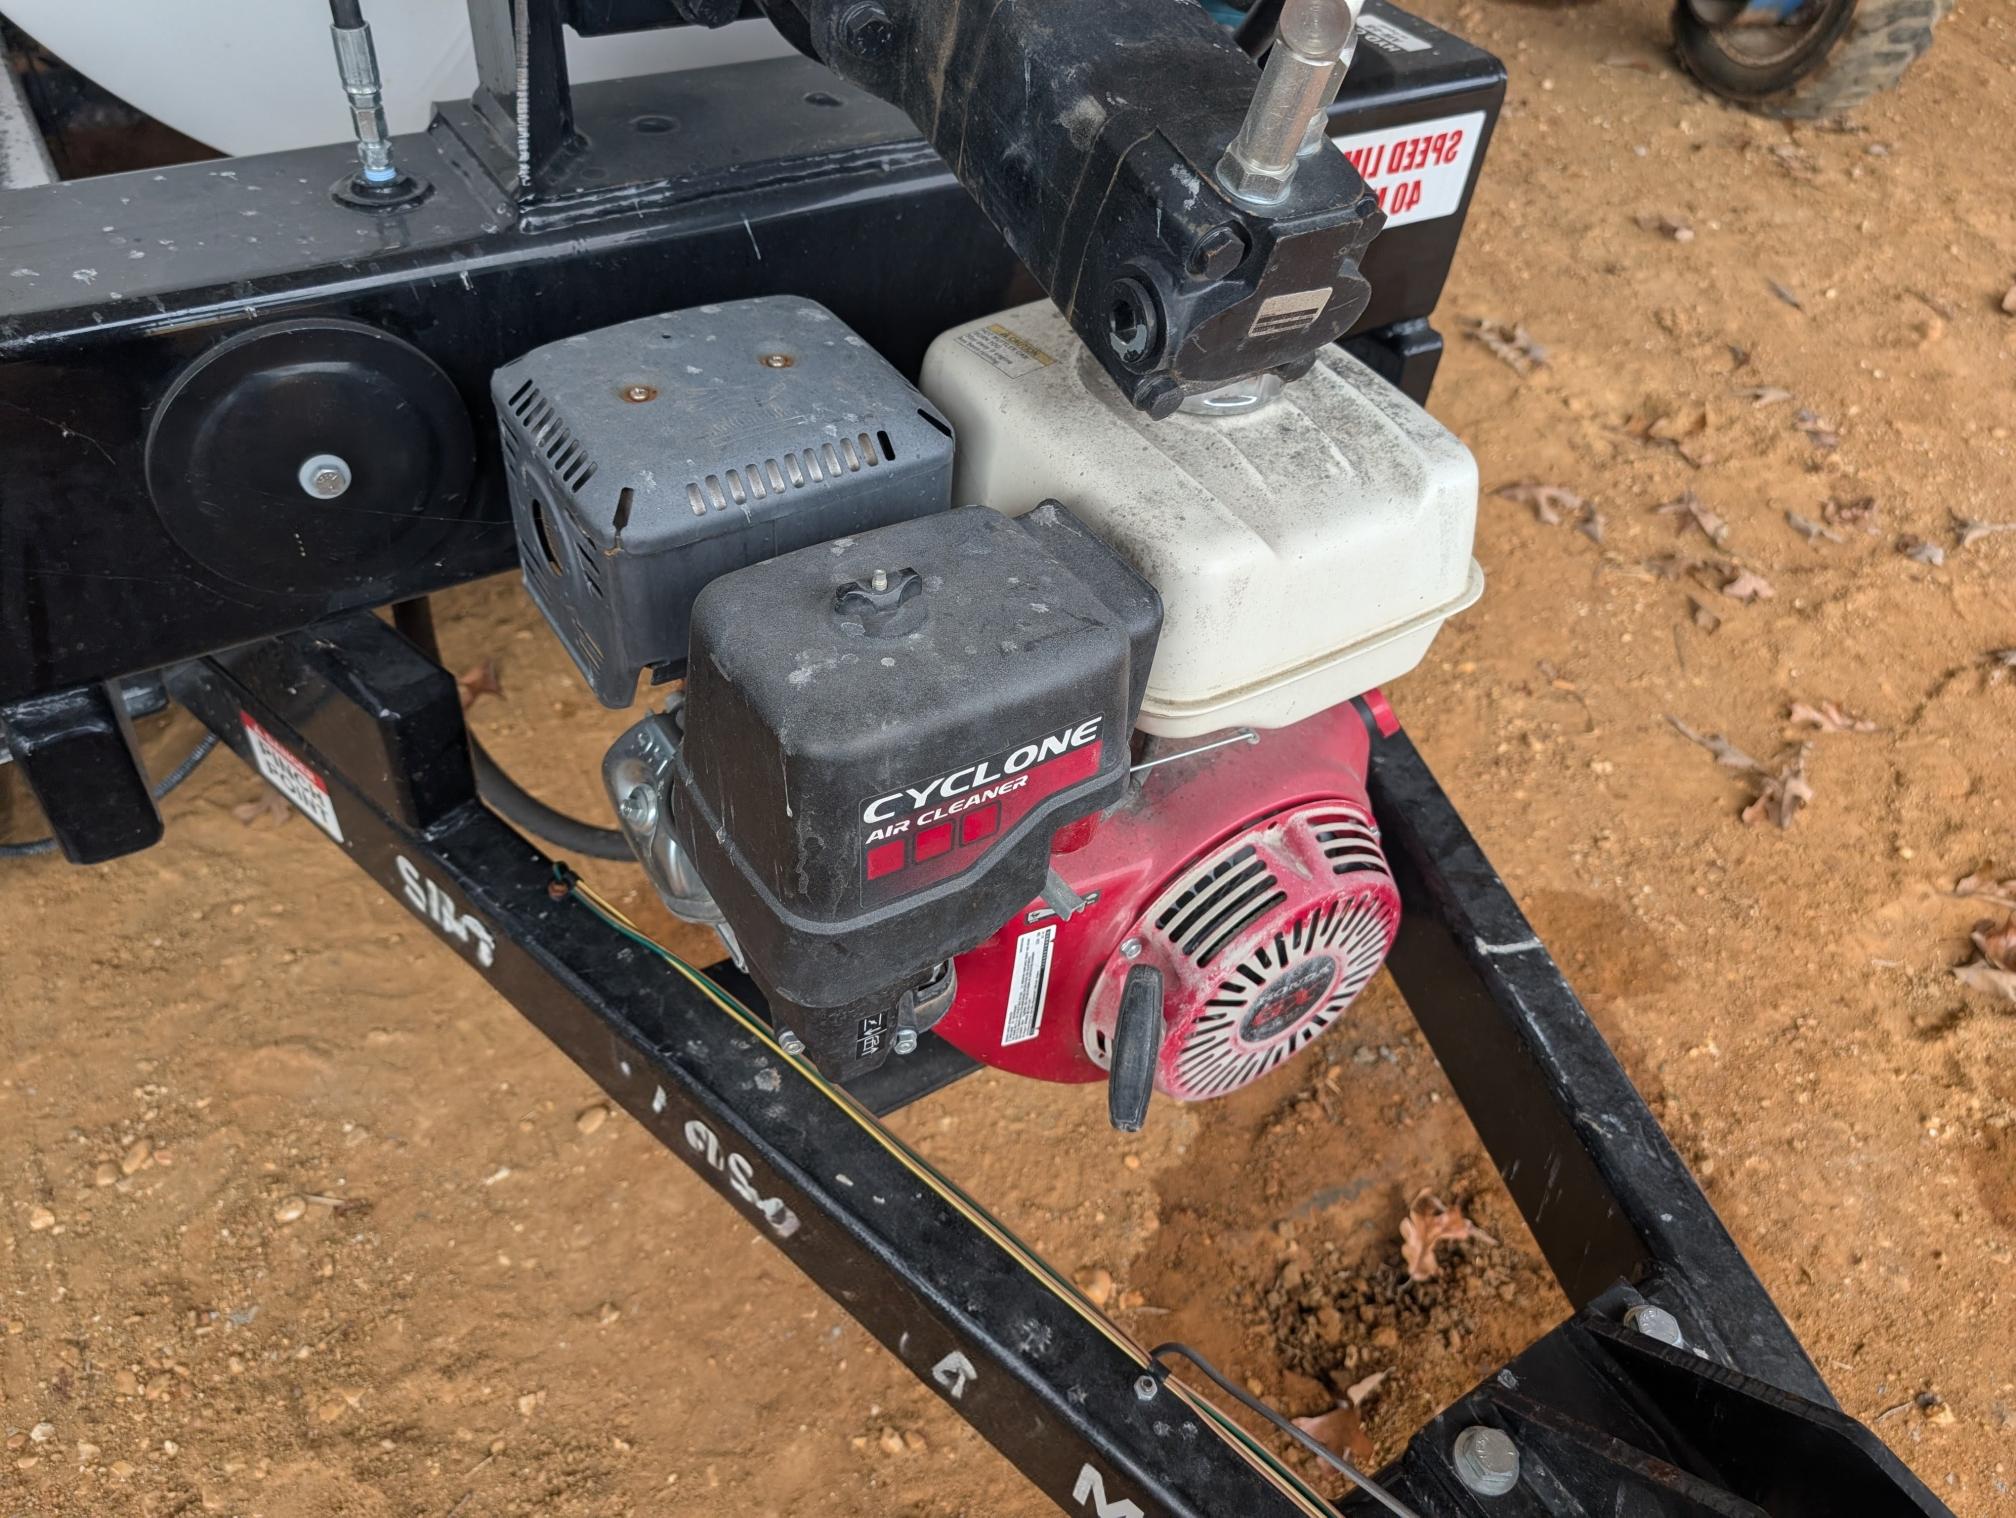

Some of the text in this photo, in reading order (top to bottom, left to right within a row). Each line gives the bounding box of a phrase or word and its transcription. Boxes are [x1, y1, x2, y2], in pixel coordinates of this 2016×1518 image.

[259, 739, 325, 807] PINCH
[266, 761, 329, 822] POINT
[863, 716, 1102, 824] CYCLONE
[865, 775, 1029, 845] AIR CLEANER
